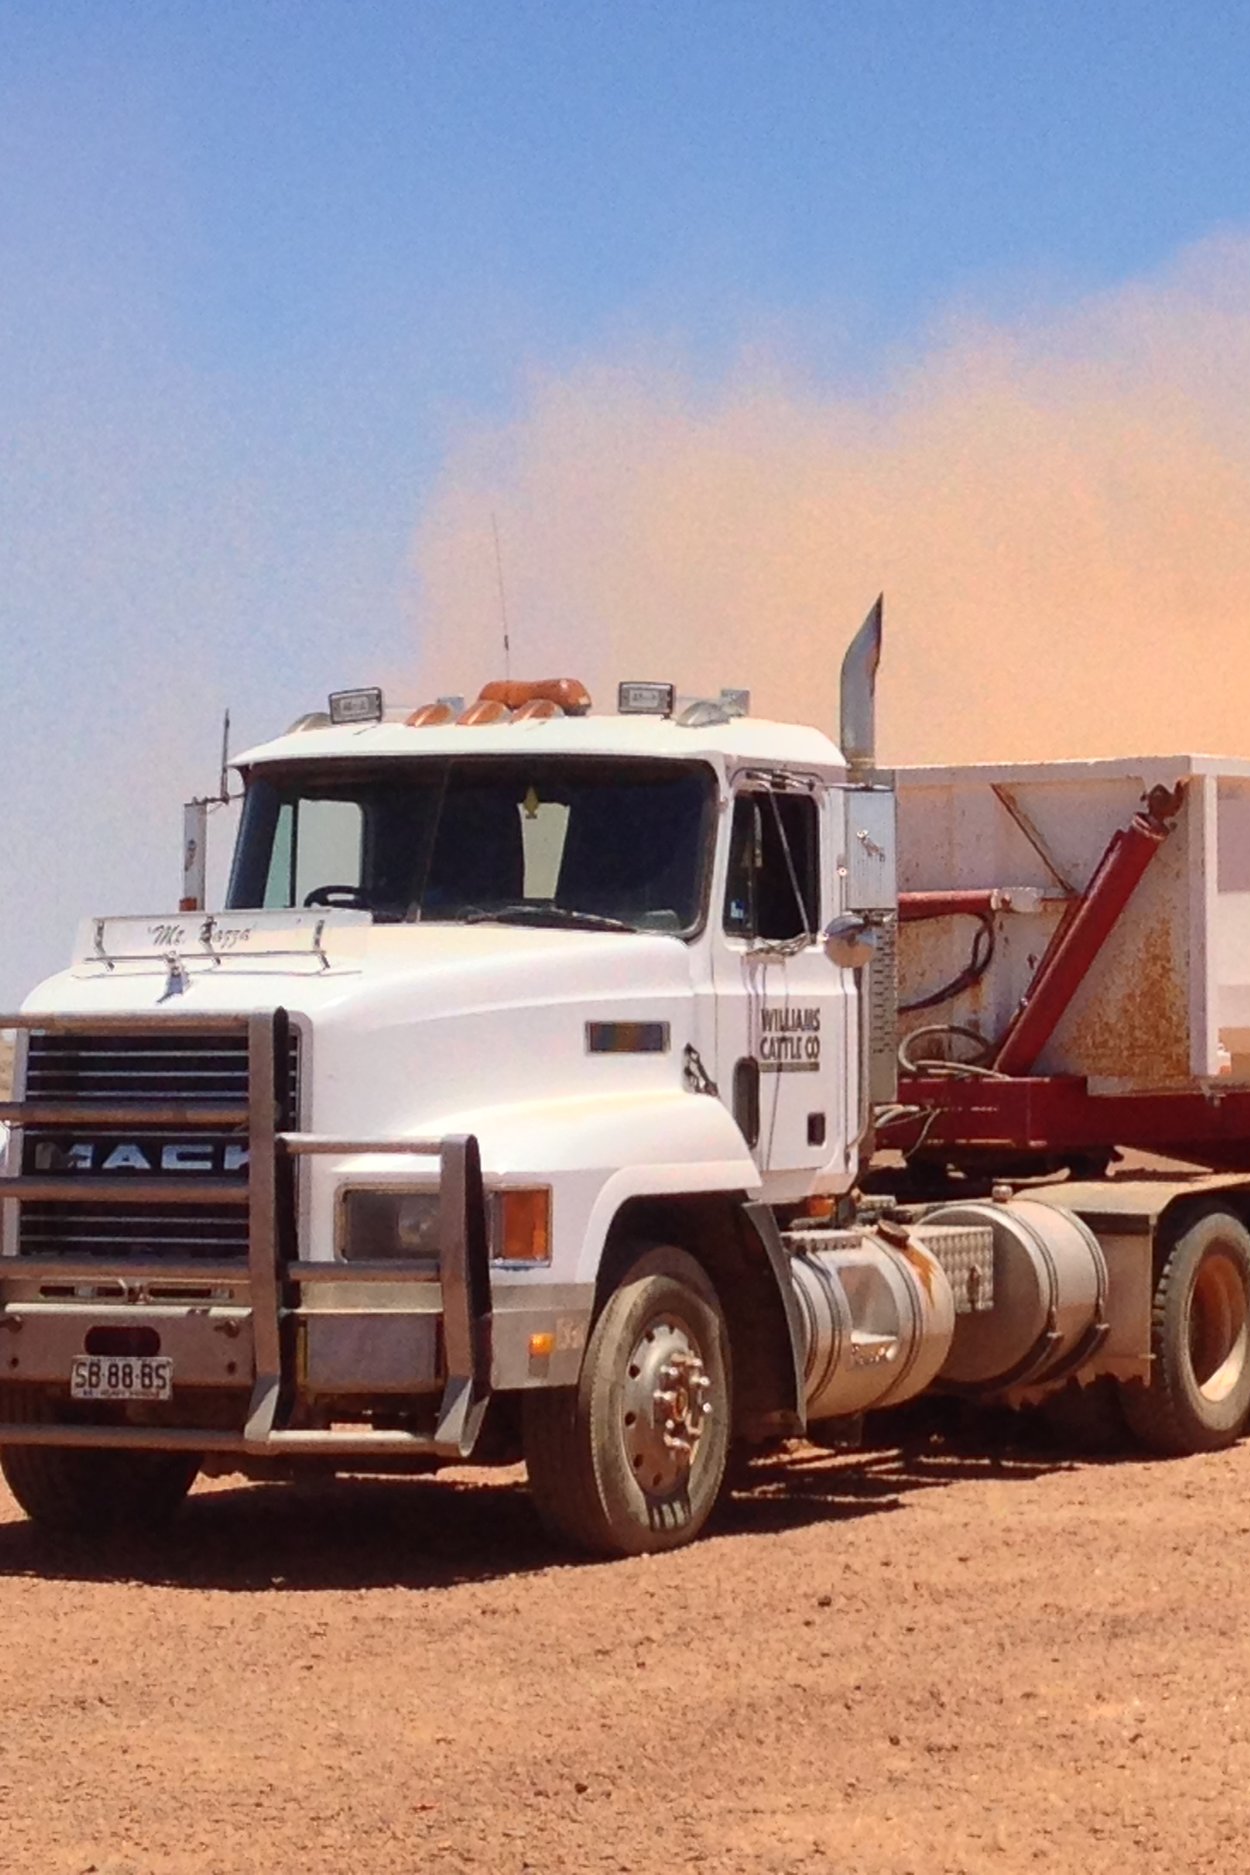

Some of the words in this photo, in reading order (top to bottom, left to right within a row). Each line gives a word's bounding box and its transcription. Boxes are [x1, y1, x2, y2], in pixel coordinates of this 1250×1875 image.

[760, 1008, 821, 1032] WILLIAMS
[759, 1035, 802, 1060] CATTLE
[804, 1035, 821, 1060] CO
